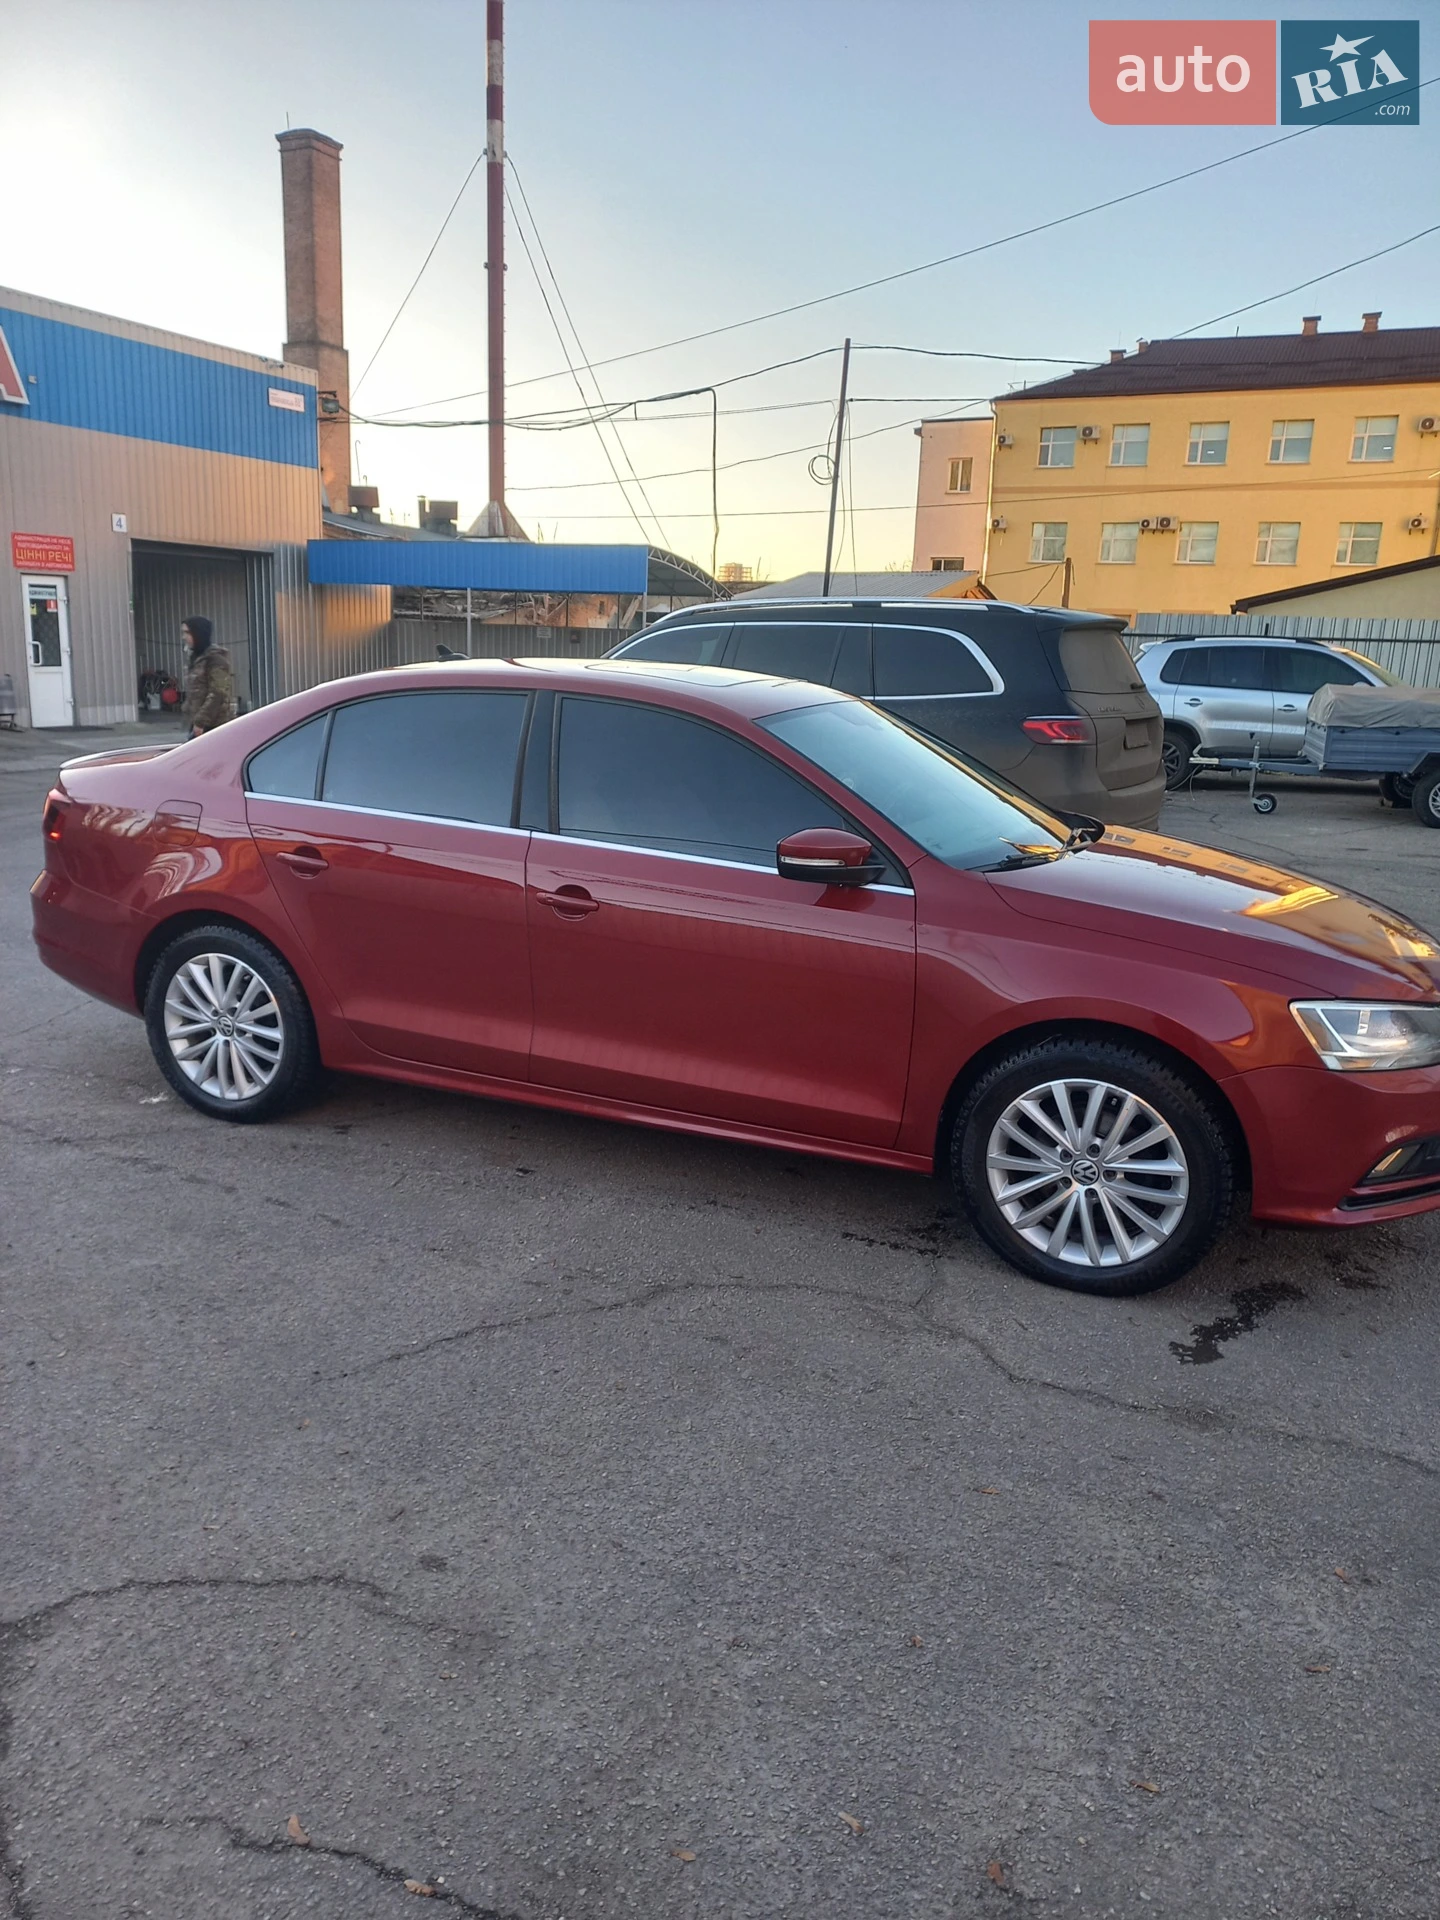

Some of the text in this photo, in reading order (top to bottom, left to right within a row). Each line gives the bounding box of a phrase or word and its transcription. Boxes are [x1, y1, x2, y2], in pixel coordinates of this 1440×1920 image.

[115, 516, 123, 529] 4
[15, 548, 72, 562] ЦІННІ РЕЧІ
